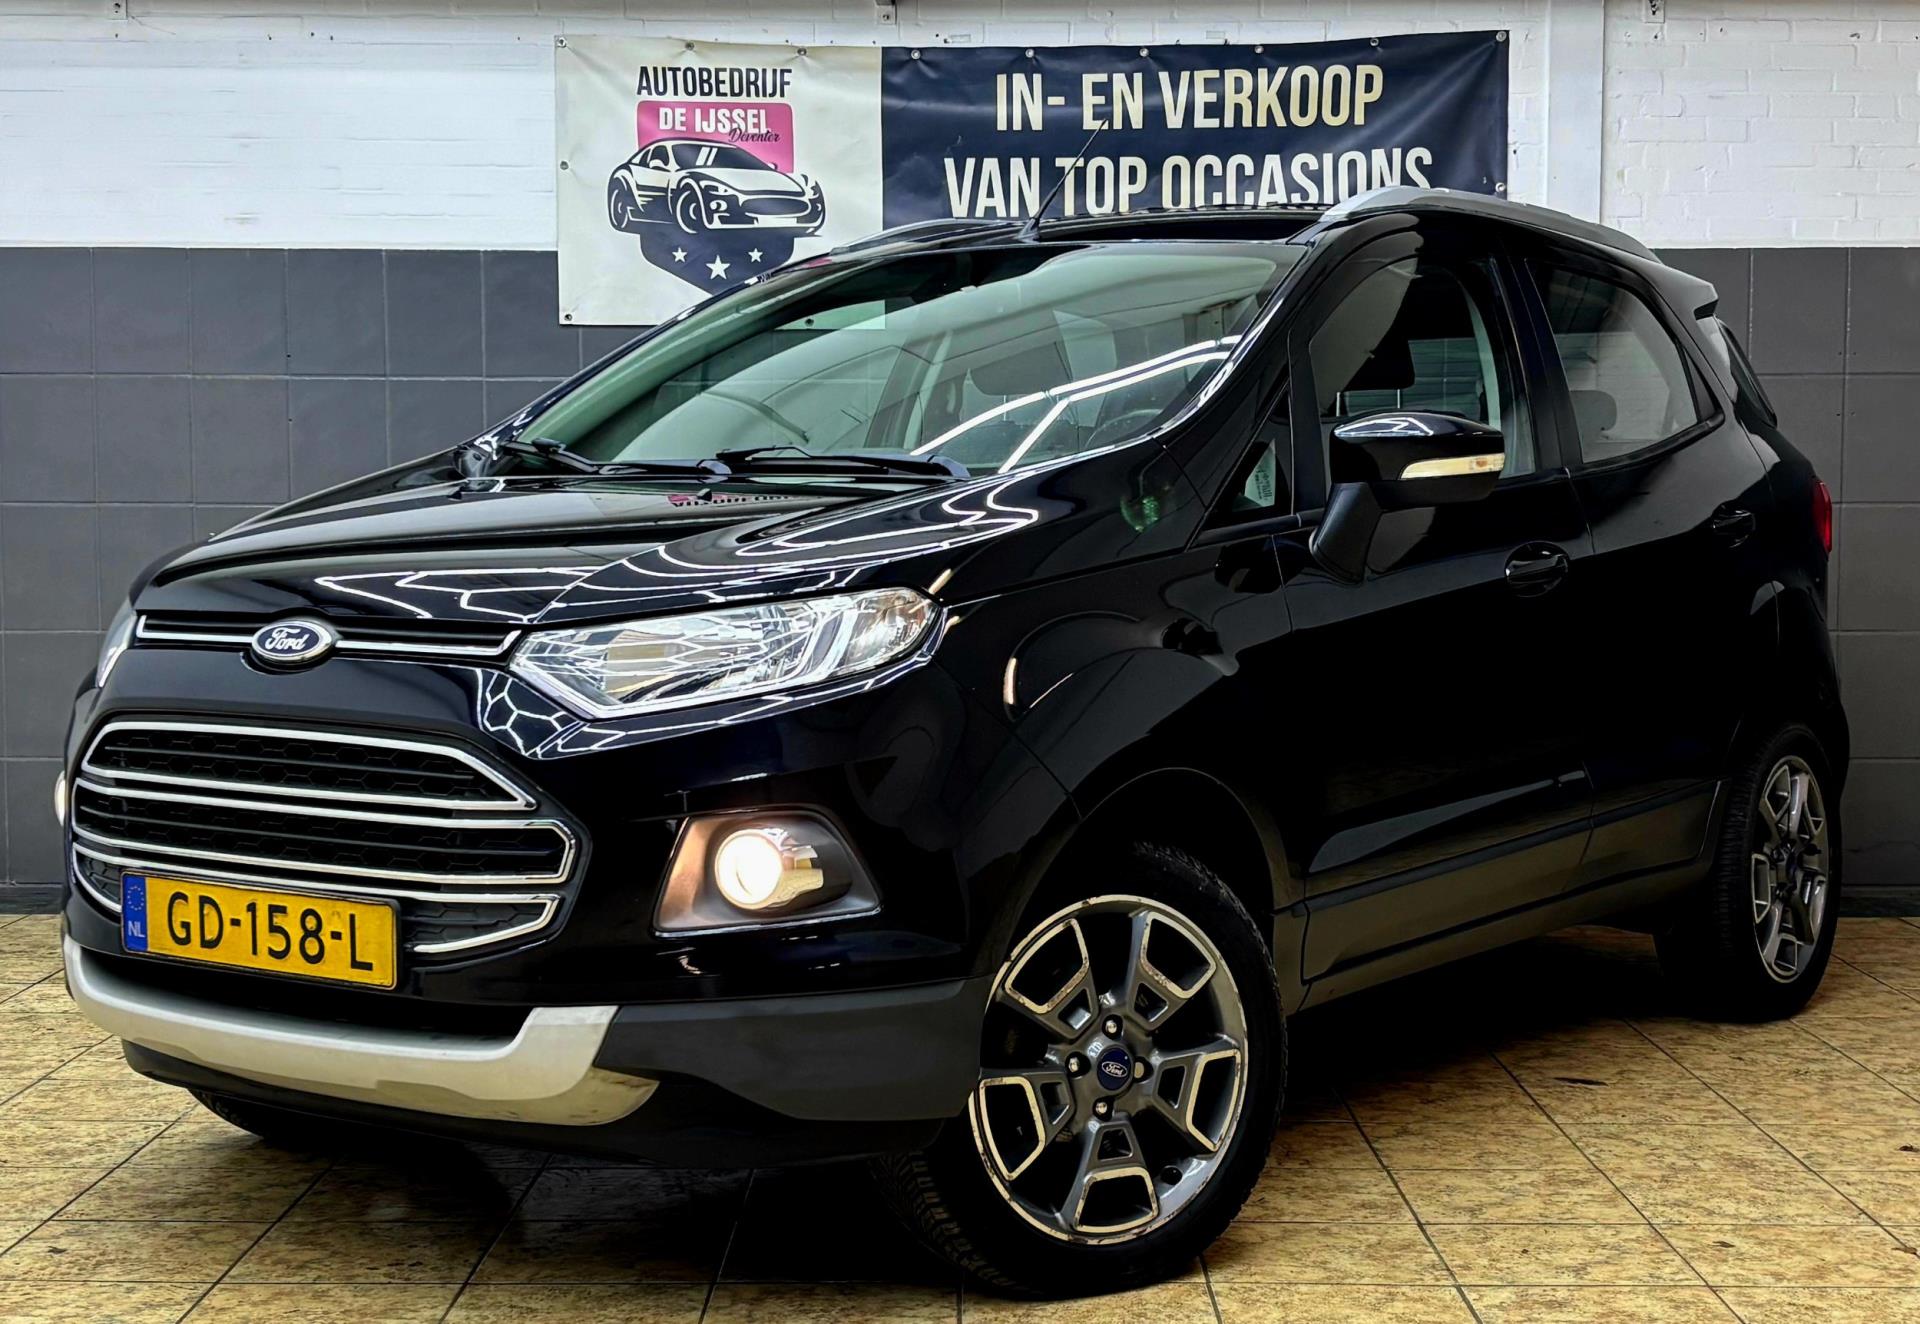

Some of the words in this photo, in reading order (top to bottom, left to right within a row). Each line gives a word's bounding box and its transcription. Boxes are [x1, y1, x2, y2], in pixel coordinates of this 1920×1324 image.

[636, 66, 793, 98] AUTOBEDRIJF
[996, 73, 1066, 131] IN-
[1082, 72, 1143, 131] EN
[1158, 64, 1384, 129] VERKOOP
[658, 107, 687, 131] DE
[695, 108, 770, 134] IJSSEL
[728, 128, 781, 143] Deventer
[944, 157, 1041, 218] VAN
[1055, 156, 1148, 217] TOP
[1162, 147, 1433, 210] OCCASIONS
[264, 626, 311, 650] Ford
[127, 919, 146, 939] NL
[166, 890, 374, 972] GD-158-L
[1105, 1063, 1125, 1077] Ford
